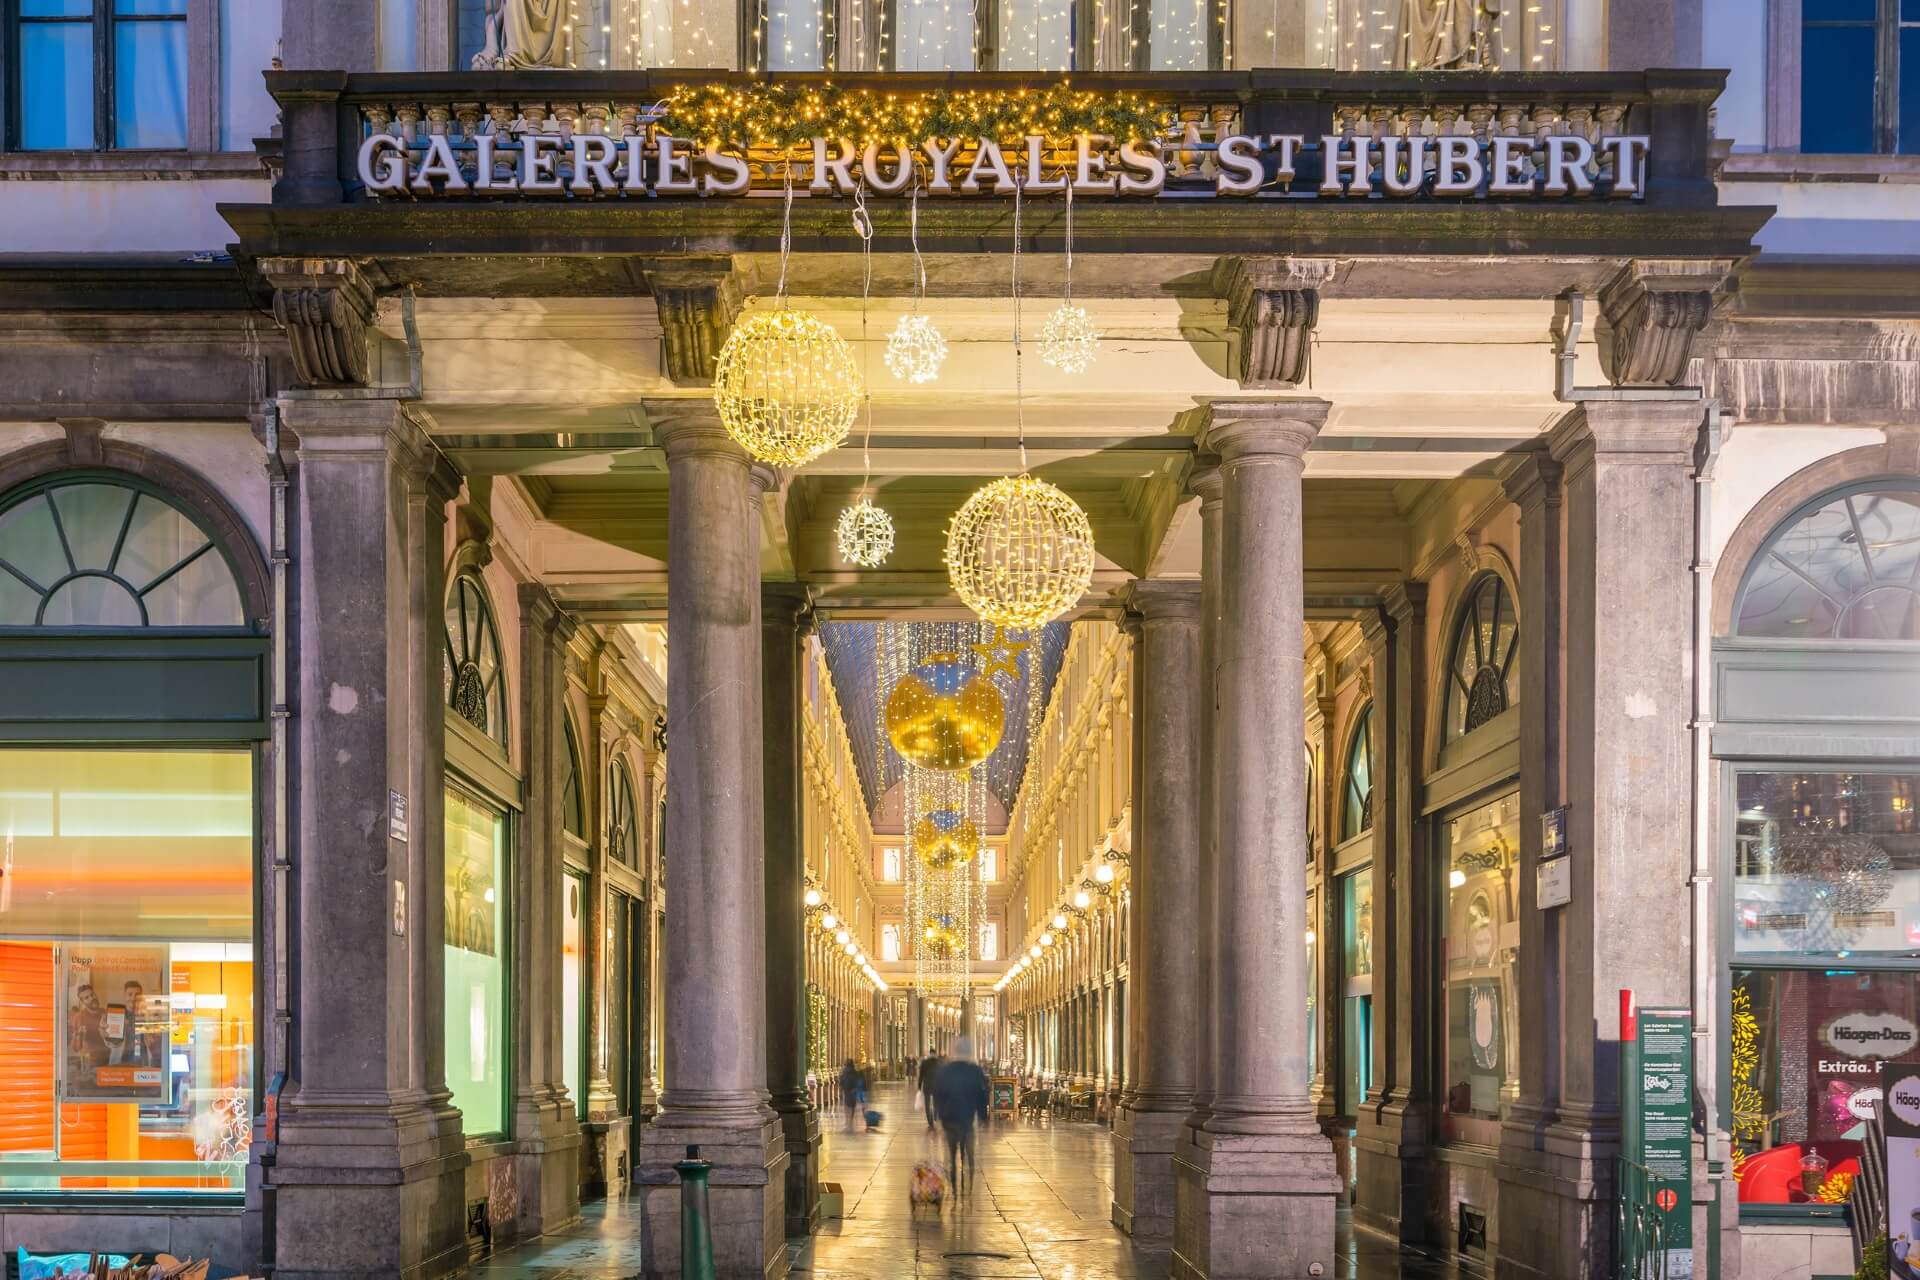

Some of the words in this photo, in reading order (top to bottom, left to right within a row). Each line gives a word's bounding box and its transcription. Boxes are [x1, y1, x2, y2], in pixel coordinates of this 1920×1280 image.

[356, 135, 751, 195] GALERIES
[810, 135, 1167, 196] ROYALES
[1215, 134, 1305, 195] ST
[1319, 134, 1652, 195] HUBERT
[1834, 1026, 1912, 1043] Häagen-Dazs
